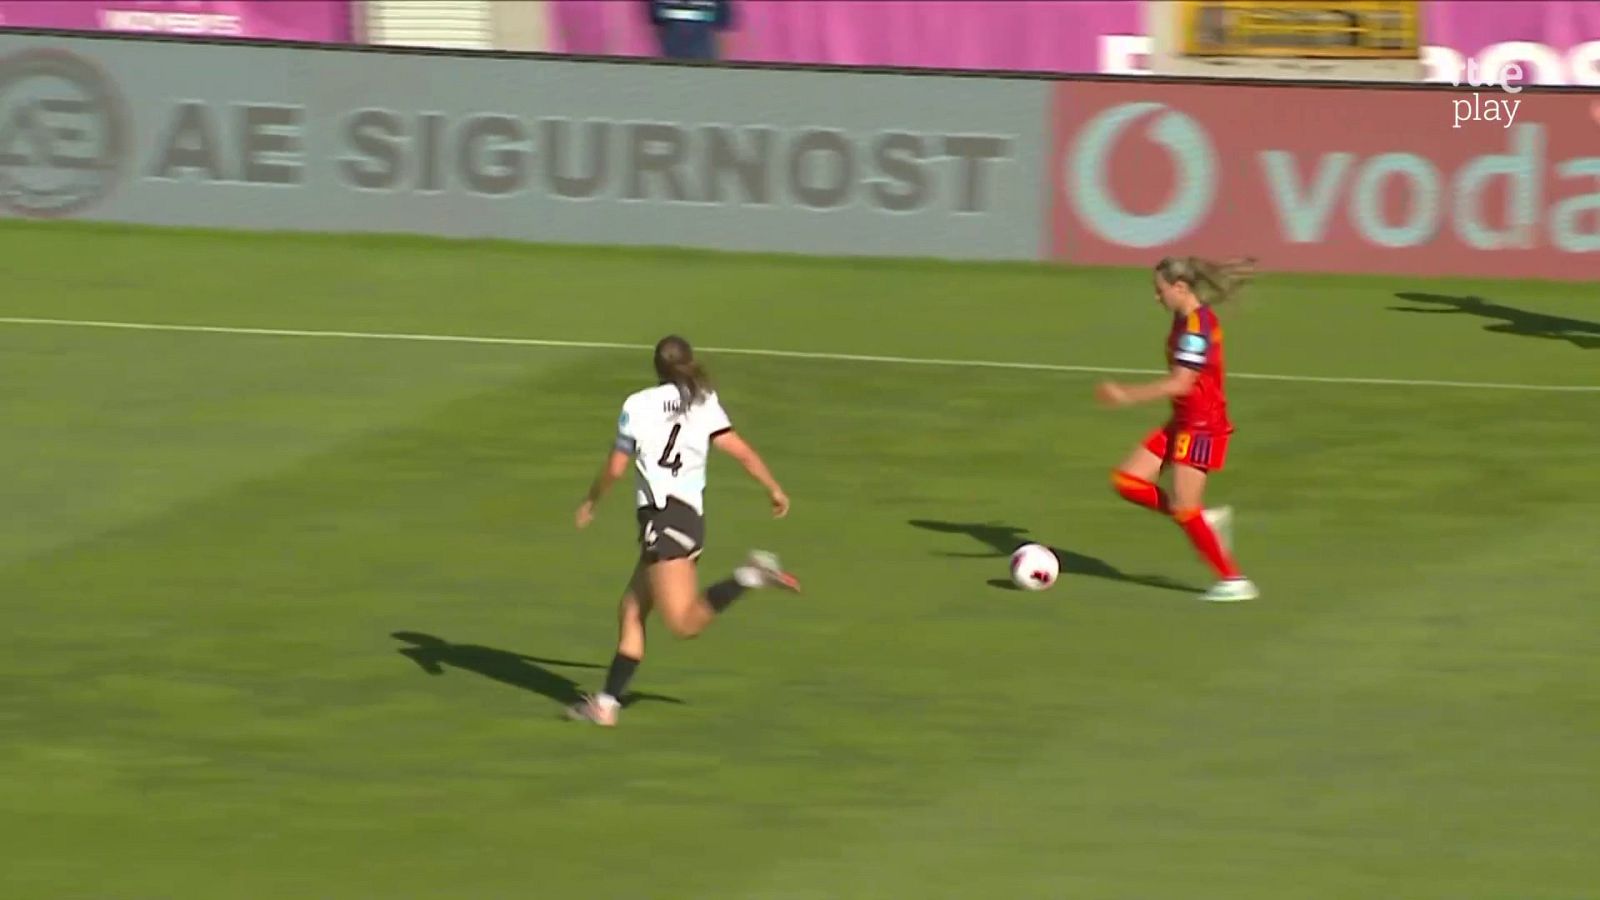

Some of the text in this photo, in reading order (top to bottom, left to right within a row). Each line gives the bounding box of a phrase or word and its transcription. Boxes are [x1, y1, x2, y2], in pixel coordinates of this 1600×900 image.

[146, 101, 1018, 215] AE SIGURNOST
[657, 422, 683, 478] 4
